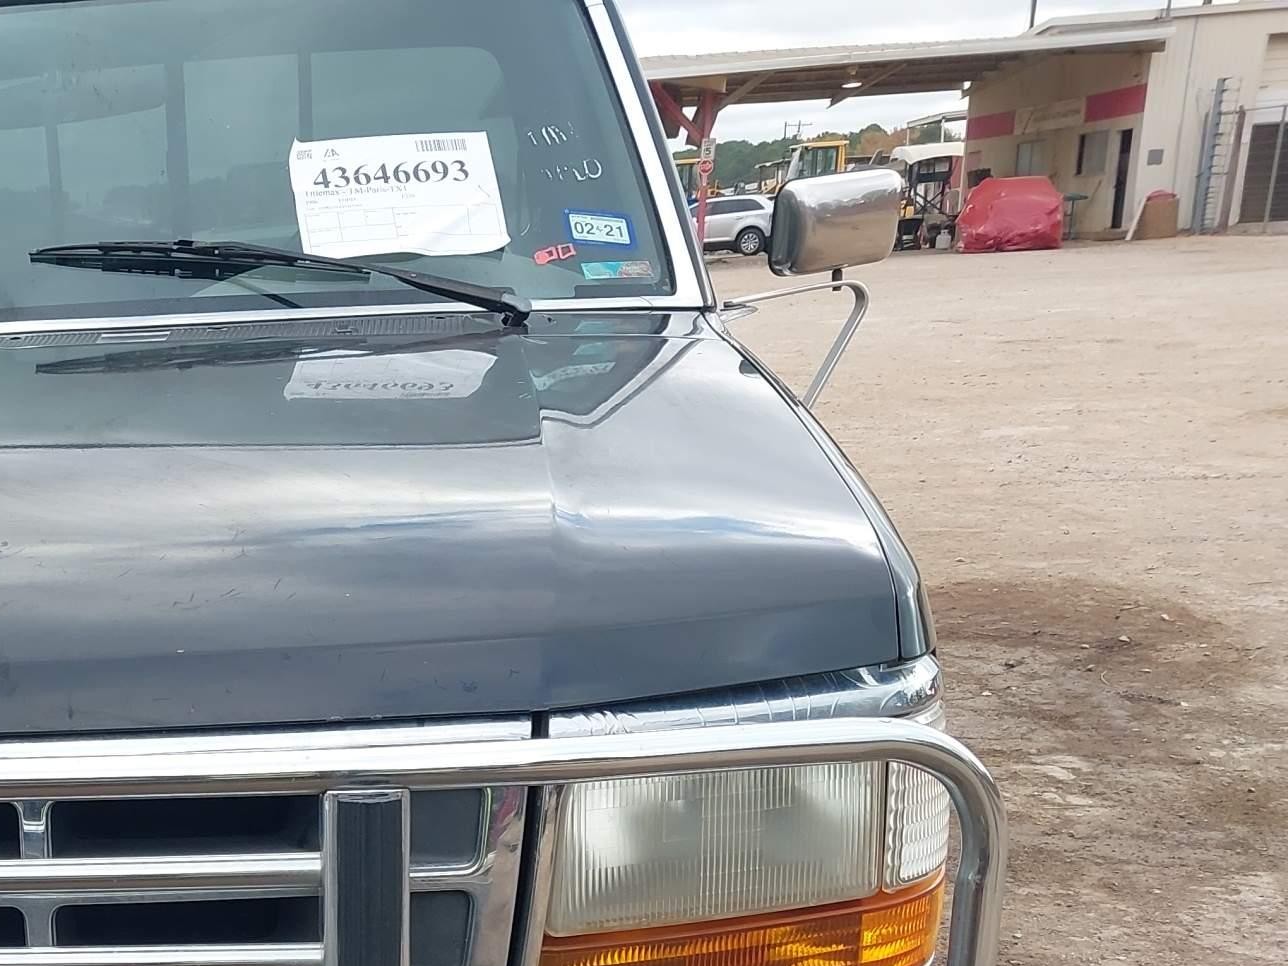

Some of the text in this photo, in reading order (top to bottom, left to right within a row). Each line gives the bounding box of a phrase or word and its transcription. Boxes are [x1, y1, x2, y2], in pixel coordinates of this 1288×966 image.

[312, 159, 470, 189] 43646693
[574, 221, 624, 239] 02 21
